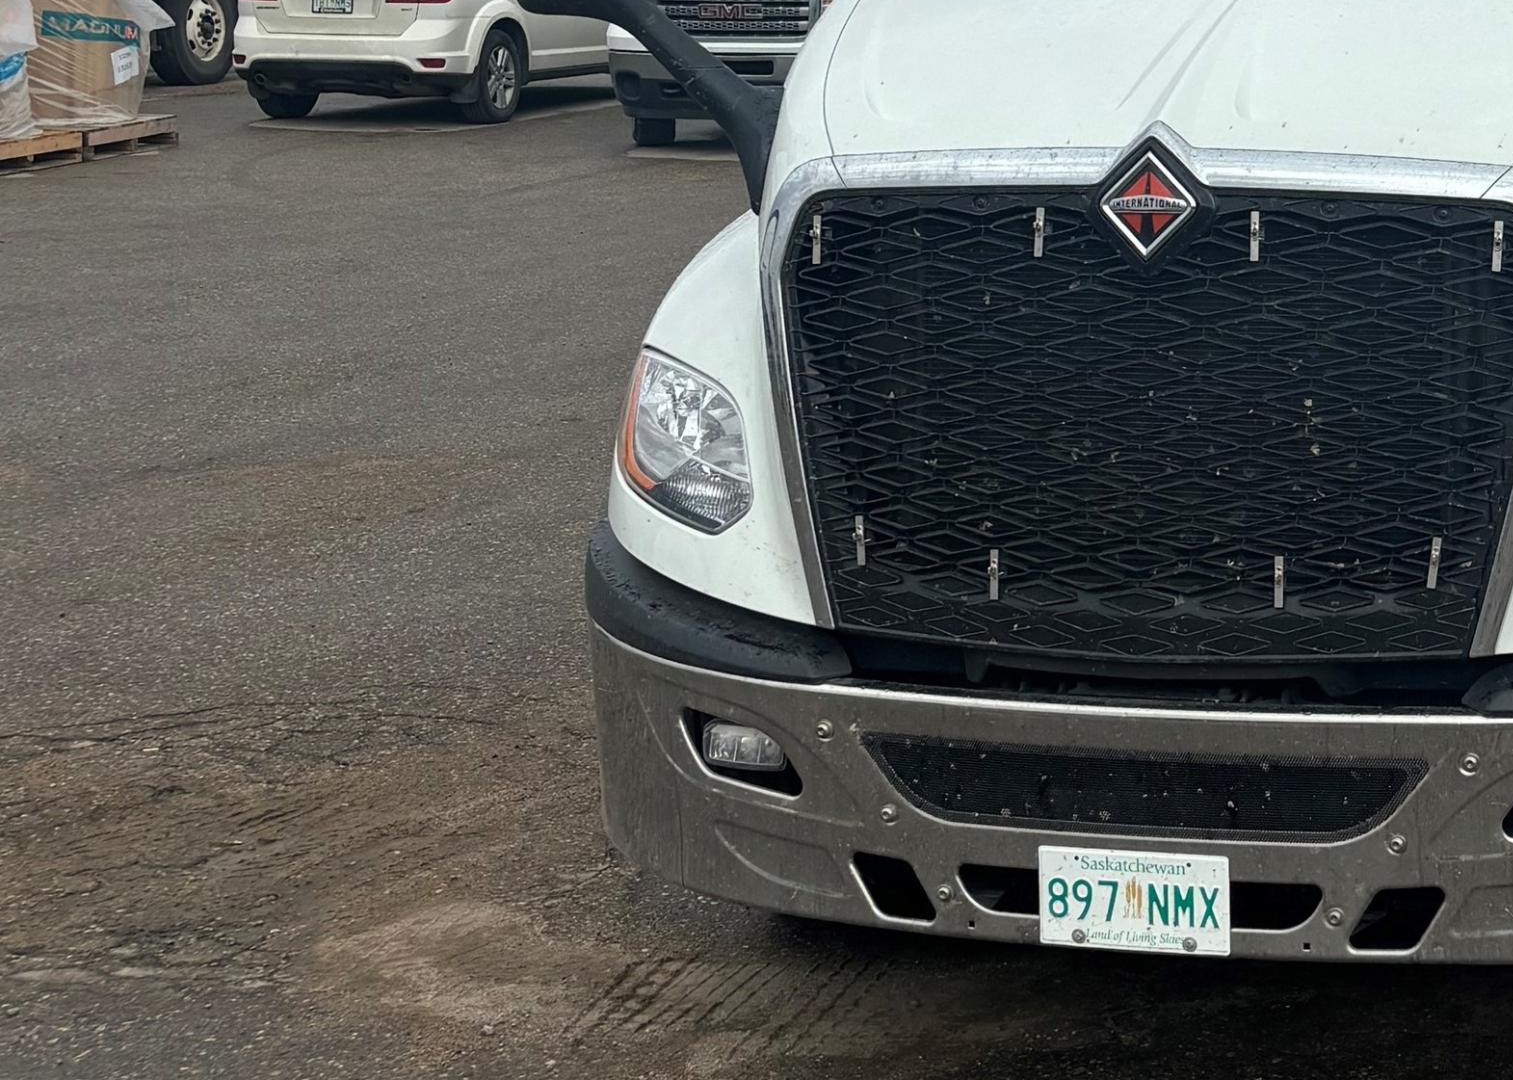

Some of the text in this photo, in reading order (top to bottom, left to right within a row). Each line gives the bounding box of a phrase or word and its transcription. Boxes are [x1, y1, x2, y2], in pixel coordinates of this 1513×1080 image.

[698, 3, 763, 19] GMC
[1111, 196, 1182, 209] INTERNATIONAL
[1080, 855, 1186, 876] Saskatchewan
[1047, 877, 1220, 929] 897 NMX
[1086, 928, 1112, 940] Land
[1114, 930, 1124, 943] of
[1126, 931, 1157, 946] Living
